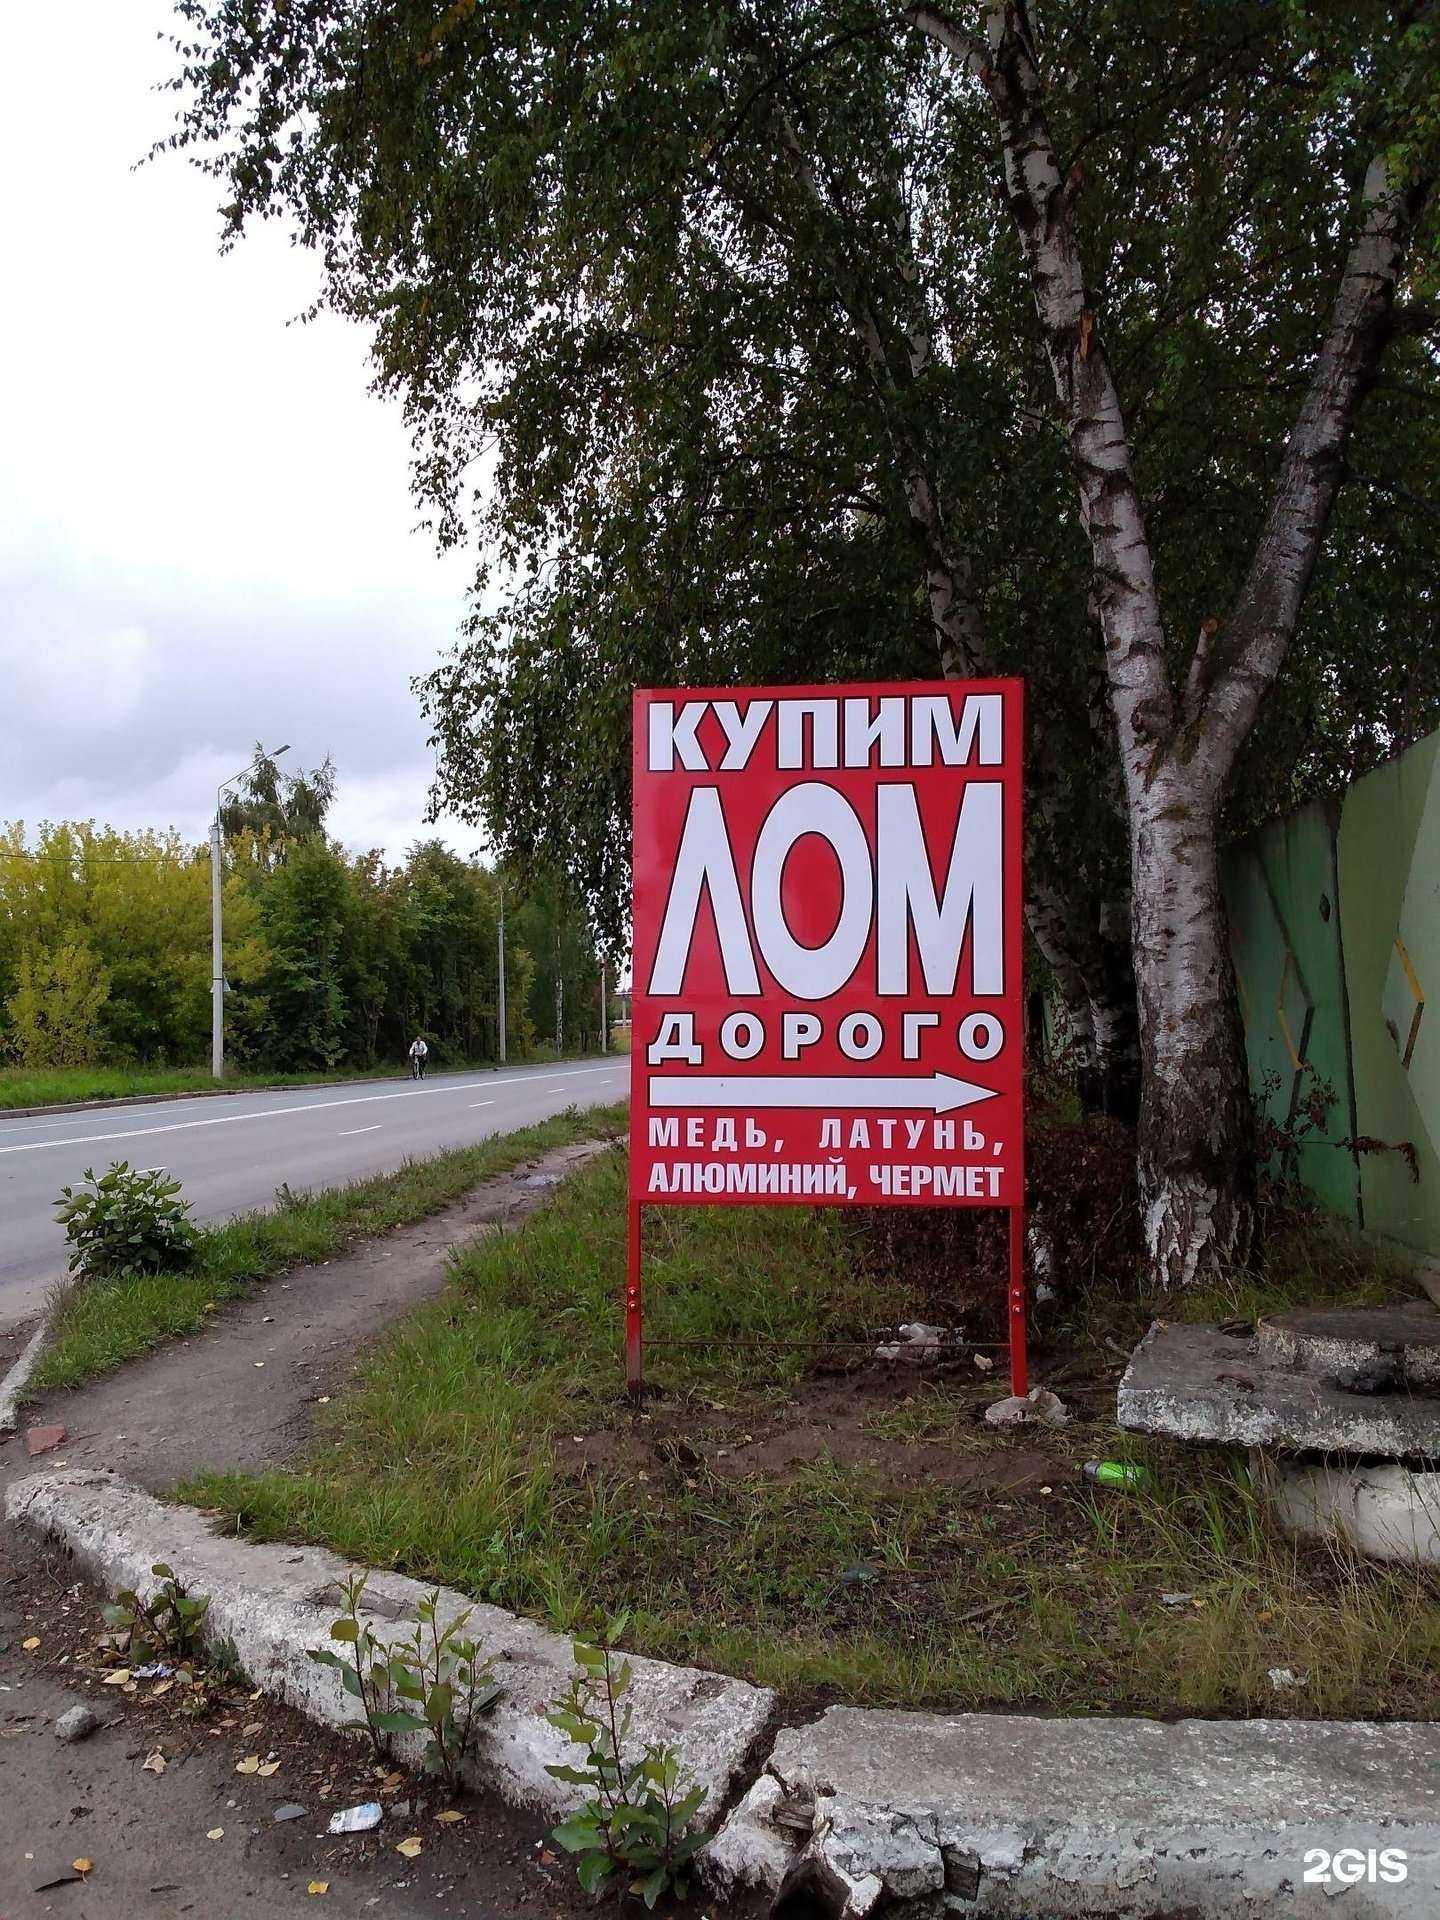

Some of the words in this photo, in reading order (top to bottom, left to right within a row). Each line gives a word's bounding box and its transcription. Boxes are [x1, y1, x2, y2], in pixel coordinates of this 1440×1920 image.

[647, 694, 1004, 771] КУПИМ
[647, 781, 1005, 1000] ЛОМ
[646, 1012, 1005, 1065] ДОРОГО
[648, 1117, 785, 1152] МЕДЬ,
[818, 1118, 1005, 1155] ЛАТУНЬ,
[648, 1157, 857, 1199] АЛЮМИНИЙ,
[869, 1165, 1005, 1198] ЧЕРМЕТ
